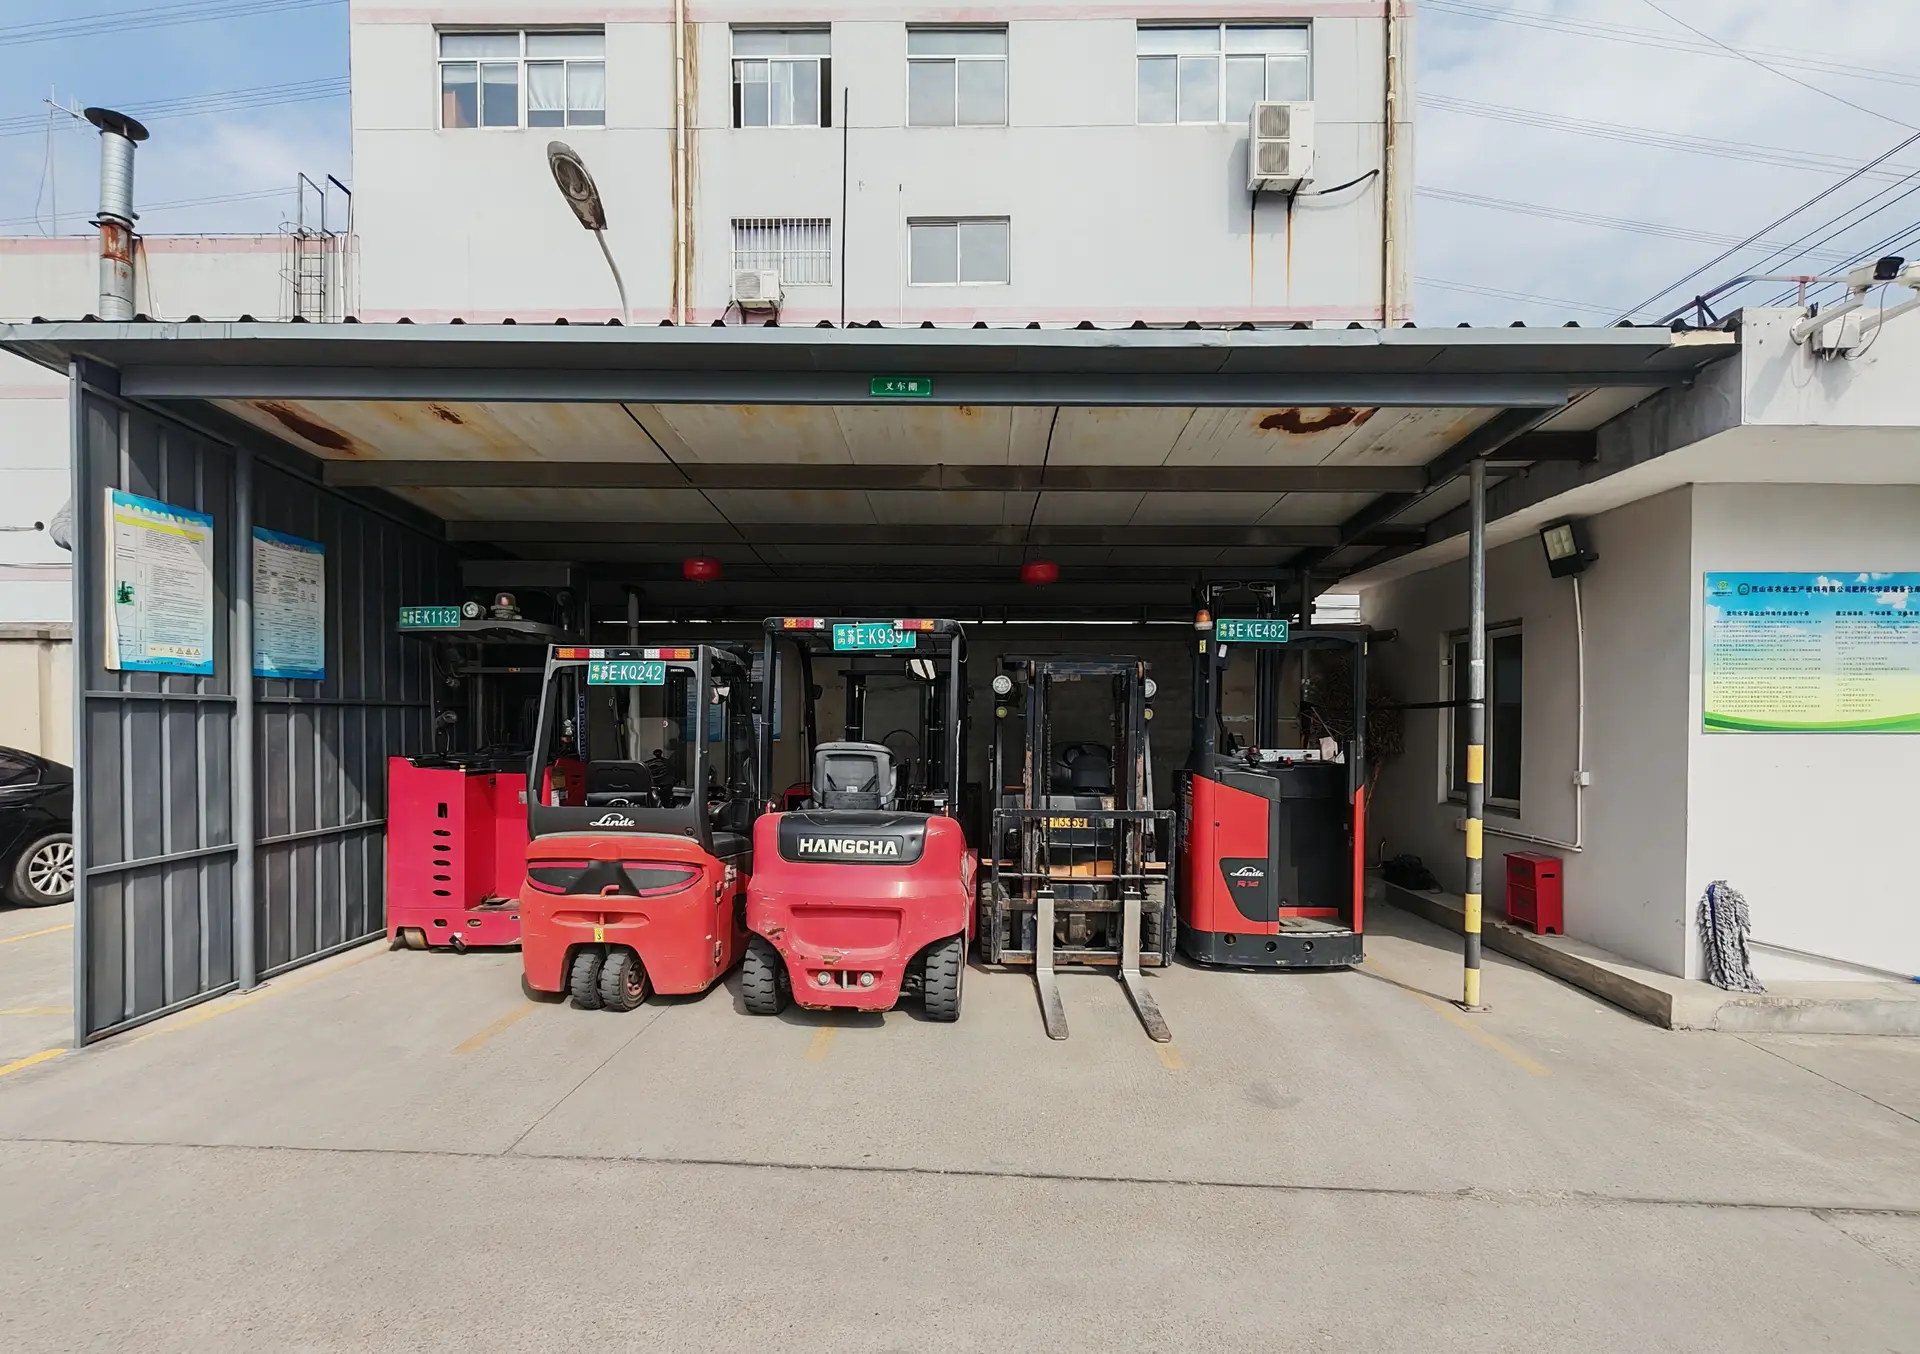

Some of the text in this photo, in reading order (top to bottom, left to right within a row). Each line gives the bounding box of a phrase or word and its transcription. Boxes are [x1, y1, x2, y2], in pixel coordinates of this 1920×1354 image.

[589, 812, 636, 827] Linde
[800, 838, 898, 855] HANGCHA
[1230, 866, 1264, 877] Linde
